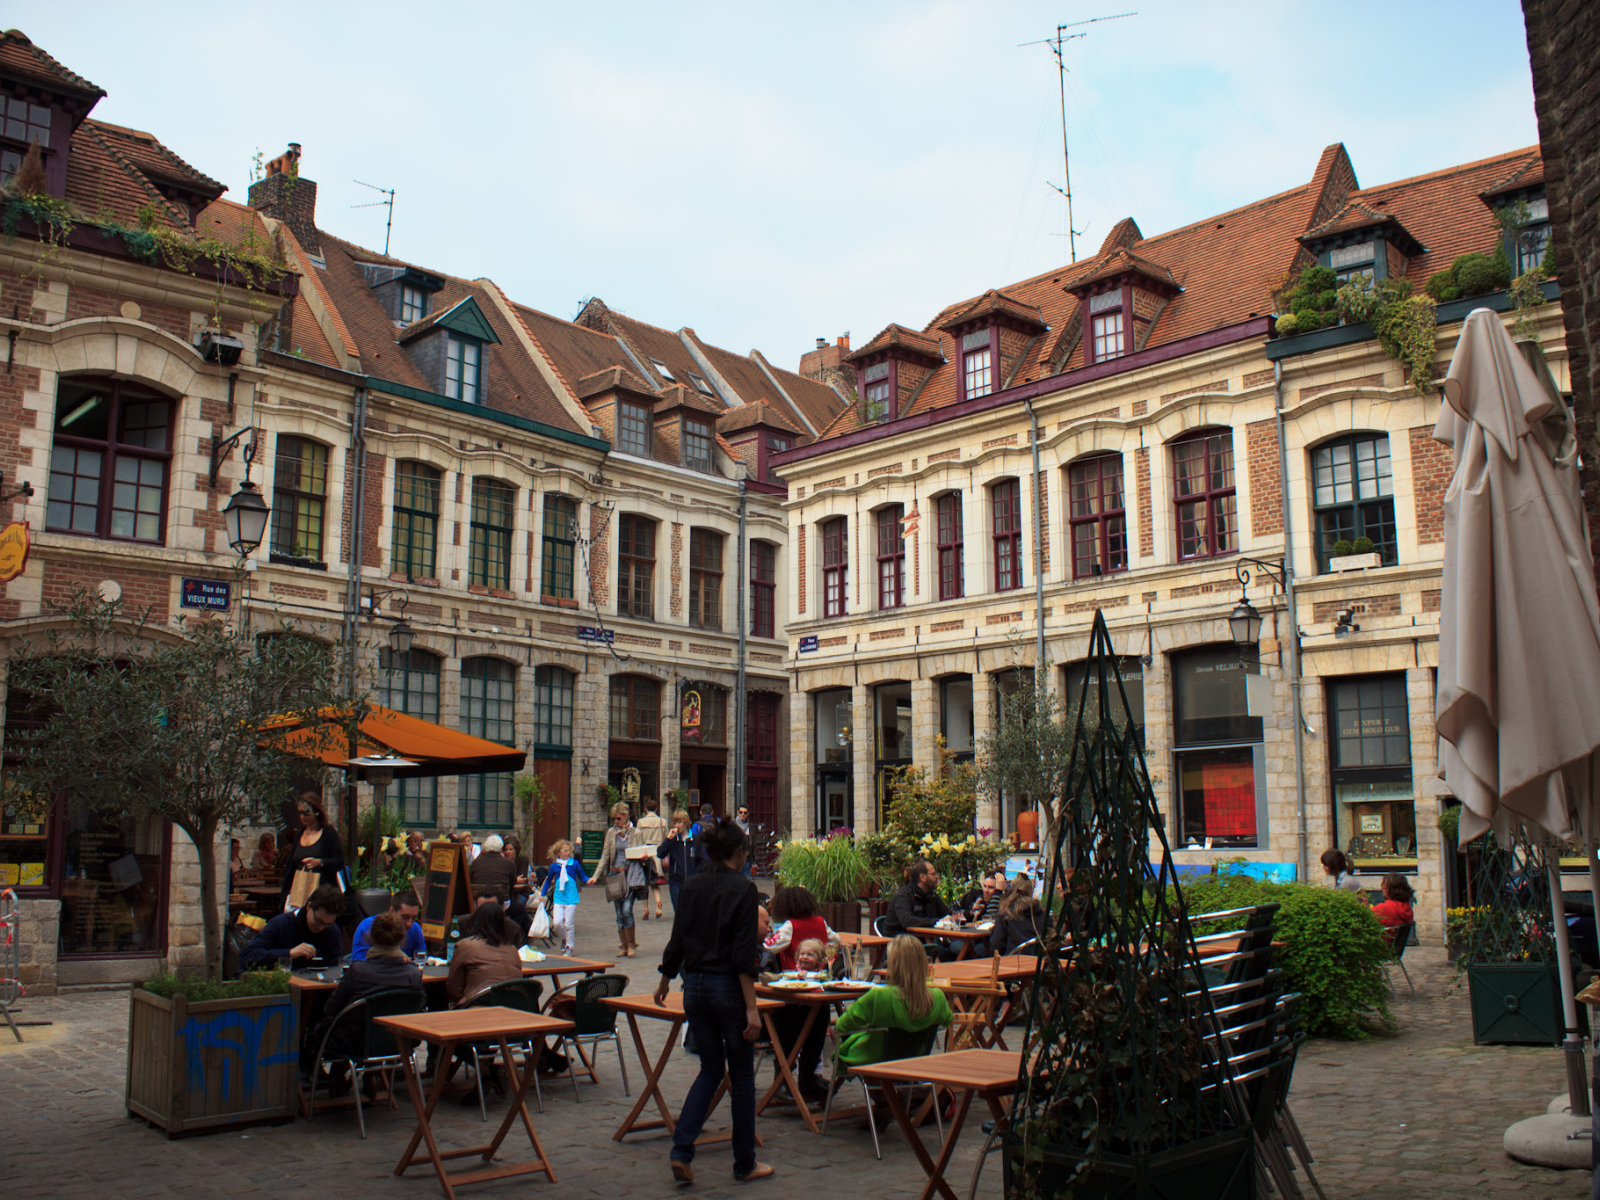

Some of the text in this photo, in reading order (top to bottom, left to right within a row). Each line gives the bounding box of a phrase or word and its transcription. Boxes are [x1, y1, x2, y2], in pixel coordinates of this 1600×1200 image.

[202, 584, 227, 595] Rue des
[187, 594, 226, 606] VIEUX MURS
[1215, 662, 1250, 671] VELJKOIC
